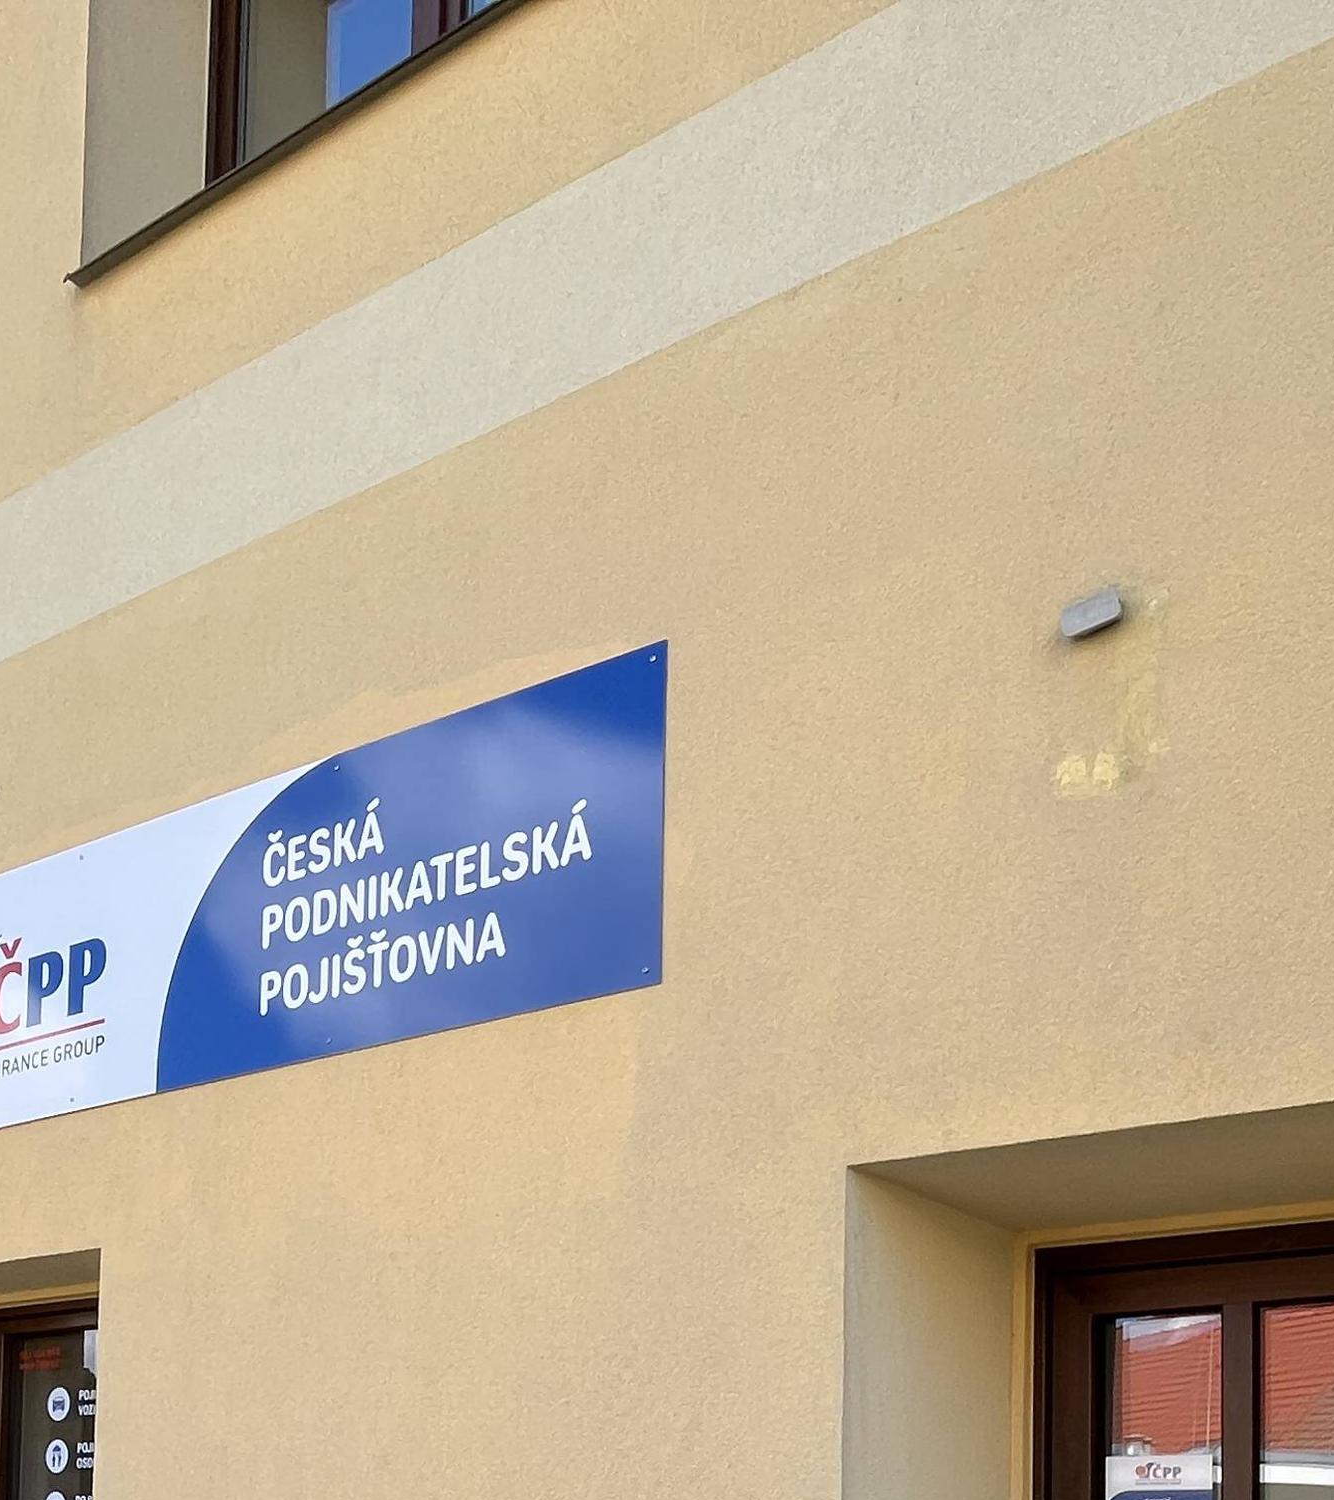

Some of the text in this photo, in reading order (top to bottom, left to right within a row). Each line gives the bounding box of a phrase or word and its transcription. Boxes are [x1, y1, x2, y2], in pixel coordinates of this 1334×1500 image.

[261, 798, 593, 951] PODNIKATELSKÁ
[262, 797, 384, 888] ČESKÁ
[258, 911, 507, 1017] POJIŠŤOVNA
[53, 1035, 106, 1064] GROUP
[1153, 1463, 1181, 1479] ČPP
